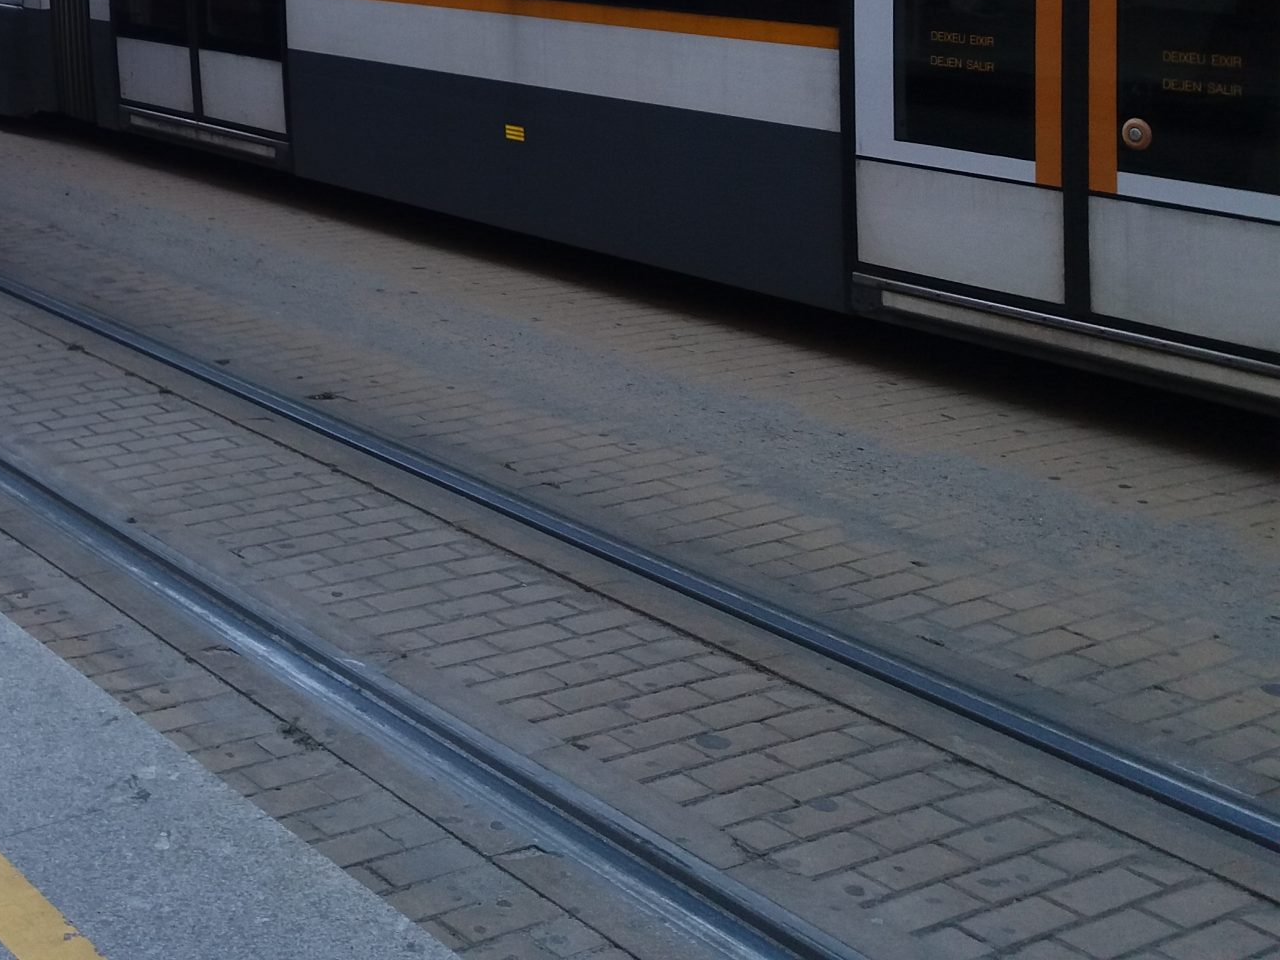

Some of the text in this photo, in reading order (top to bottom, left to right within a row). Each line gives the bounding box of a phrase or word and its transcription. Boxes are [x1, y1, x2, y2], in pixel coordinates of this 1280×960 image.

[930, 30, 994, 47] DEIXEU EIXIR
[930, 55, 995, 72] DEJEN SALIR
[1162, 50, 1243, 68] DEIXEU EIXIR
[1162, 78, 1243, 96] DEJEN SALIR
